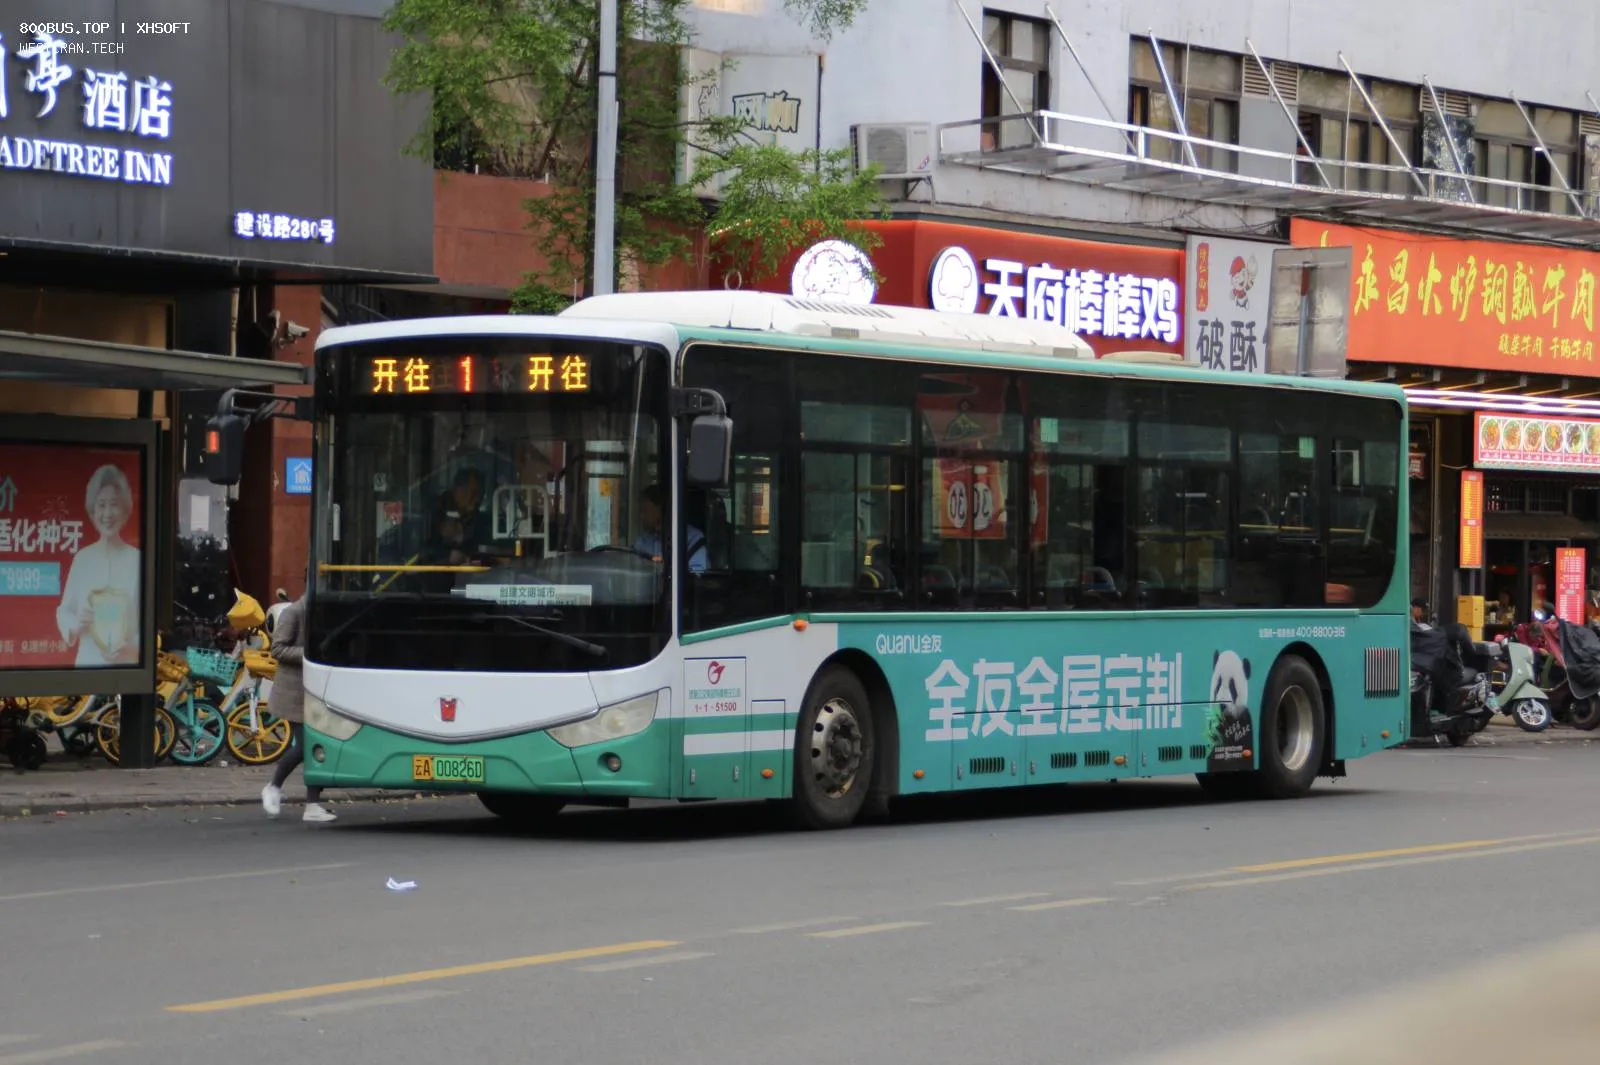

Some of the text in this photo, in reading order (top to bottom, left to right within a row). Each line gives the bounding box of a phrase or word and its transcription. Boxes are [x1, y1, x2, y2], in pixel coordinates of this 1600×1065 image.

[124, 150, 172, 185] INN
[236, 211, 335, 243] 建设路280号
[984, 258, 1178, 343] 天府棒棒鸡
[1196, 317, 1268, 373] 破酥
[373, 355, 588, 393] 开往 1 开往
[924, 652, 1182, 741] 全友全屋定制
